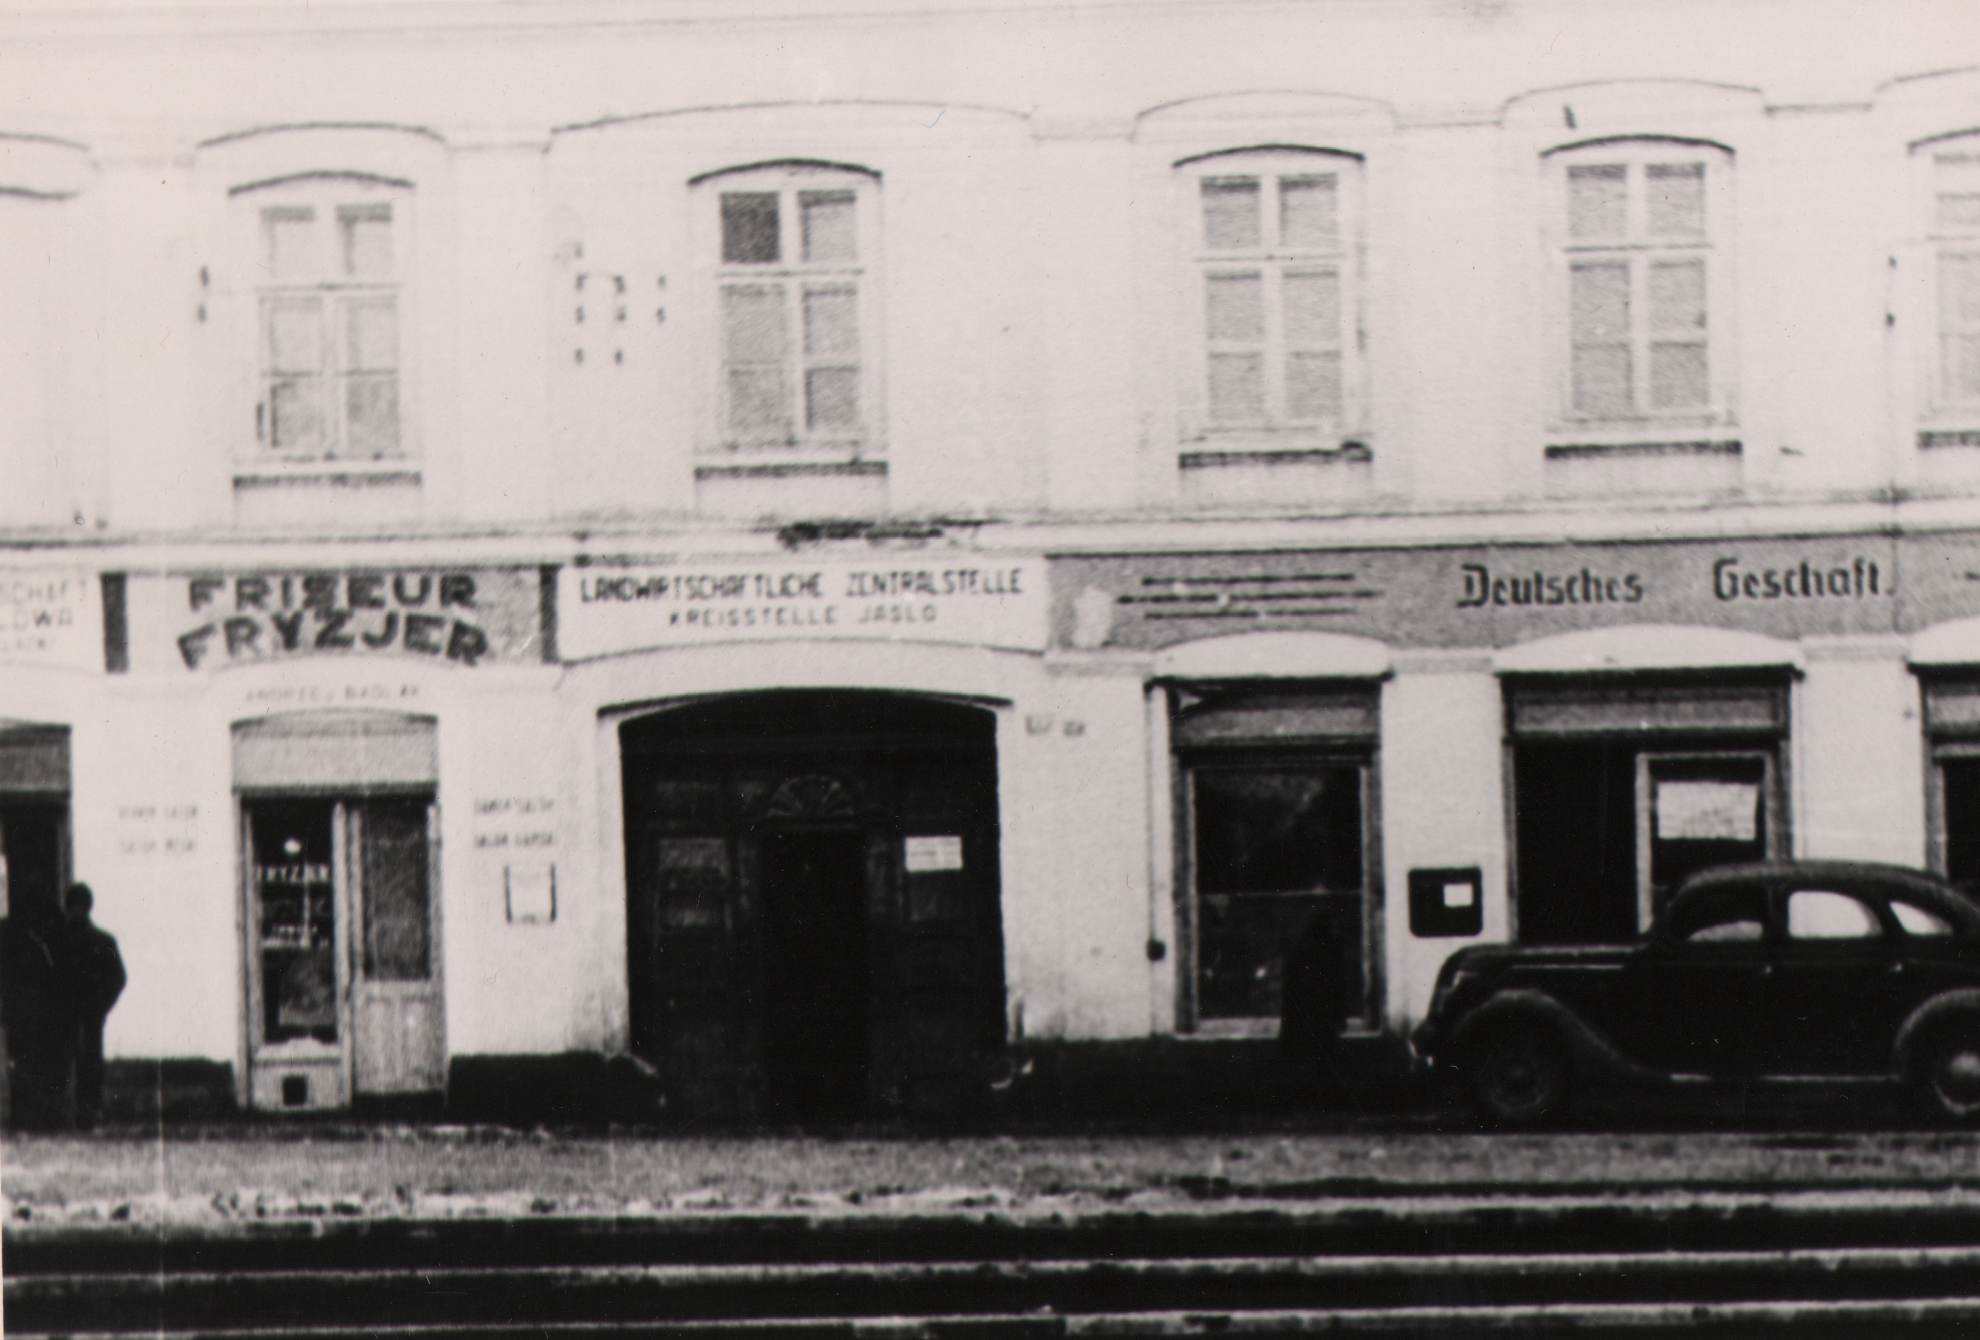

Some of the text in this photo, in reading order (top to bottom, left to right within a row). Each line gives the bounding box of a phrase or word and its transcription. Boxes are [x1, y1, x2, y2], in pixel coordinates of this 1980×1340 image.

[188, 574, 478, 611] FRISEUR
[580, 568, 1022, 602] LANDWIRTSCHAFTLICHE ZENTRALSTELLE
[1456, 564, 1643, 608] Deutsches
[669, 605, 837, 627] KREISSTELLE
[177, 610, 489, 670] FRYZJER
